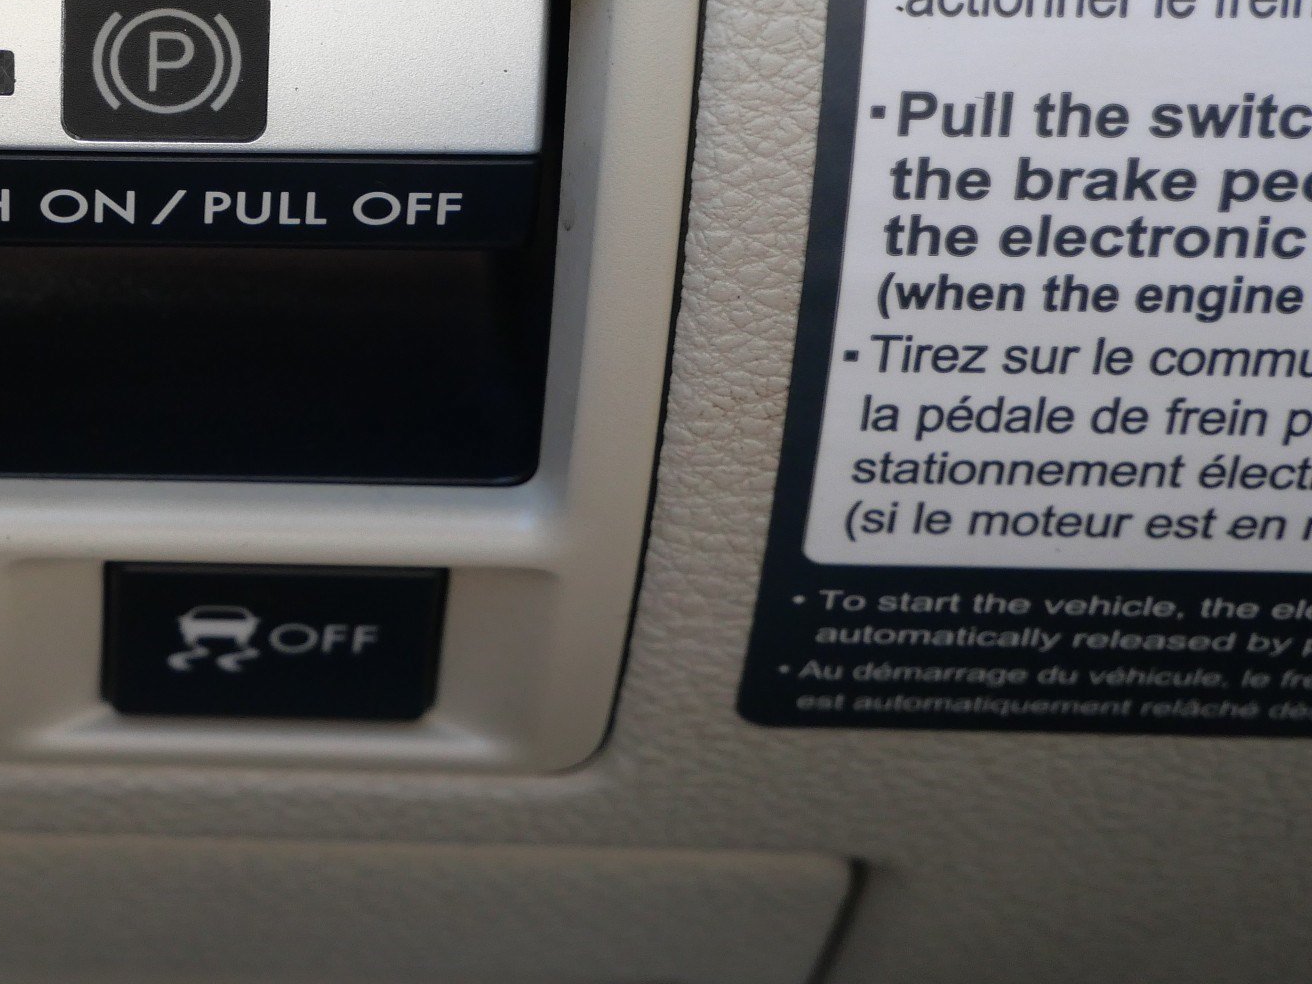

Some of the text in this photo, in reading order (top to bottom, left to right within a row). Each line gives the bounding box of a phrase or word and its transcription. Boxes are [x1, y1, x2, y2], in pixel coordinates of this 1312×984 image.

[897, 90, 1312, 140] Pull the switc
[890, 156, 1312, 213] the brake pe
[39, 188, 136, 225] ON
[203, 190, 327, 226] PULL
[352, 191, 463, 226] OFF
[883, 213, 1307, 260] the electronic
[877, 271, 1305, 324] (when the engine
[870, 334, 989, 374] Tirez
[1001, 345, 1081, 375] sur
[1092, 336, 1134, 376] le
[860, 394, 900, 433] la
[914, 395, 1075, 442] pédale
[1090, 396, 1150, 435] de
[1165, 396, 1269, 437] frein
[851, 451, 1312, 491] stationnement élect
[844, 500, 899, 543] (si
[912, 501, 953, 536] le
[967, 505, 1134, 539] moteur
[1144, 507, 1217, 540] est
[1231, 515, 1288, 541] en
[819, 589, 867, 612] To
[877, 592, 961, 613] start
[973, 592, 1032, 615] the
[1044, 595, 1184, 620] vehicle,
[1200, 597, 1260, 619] the
[268, 623, 377, 654] OFF
[814, 625, 1062, 653] automatically
[1072, 629, 1237, 652] released
[1246, 632, 1293, 657] by
[798, 659, 844, 681] Au
[852, 661, 1029, 687] démarrage
[1036, 665, 1079, 685] du
[1241, 669, 1271, 689] le
[796, 693, 845, 711] est
[852, 694, 1133, 717] automatiquement
